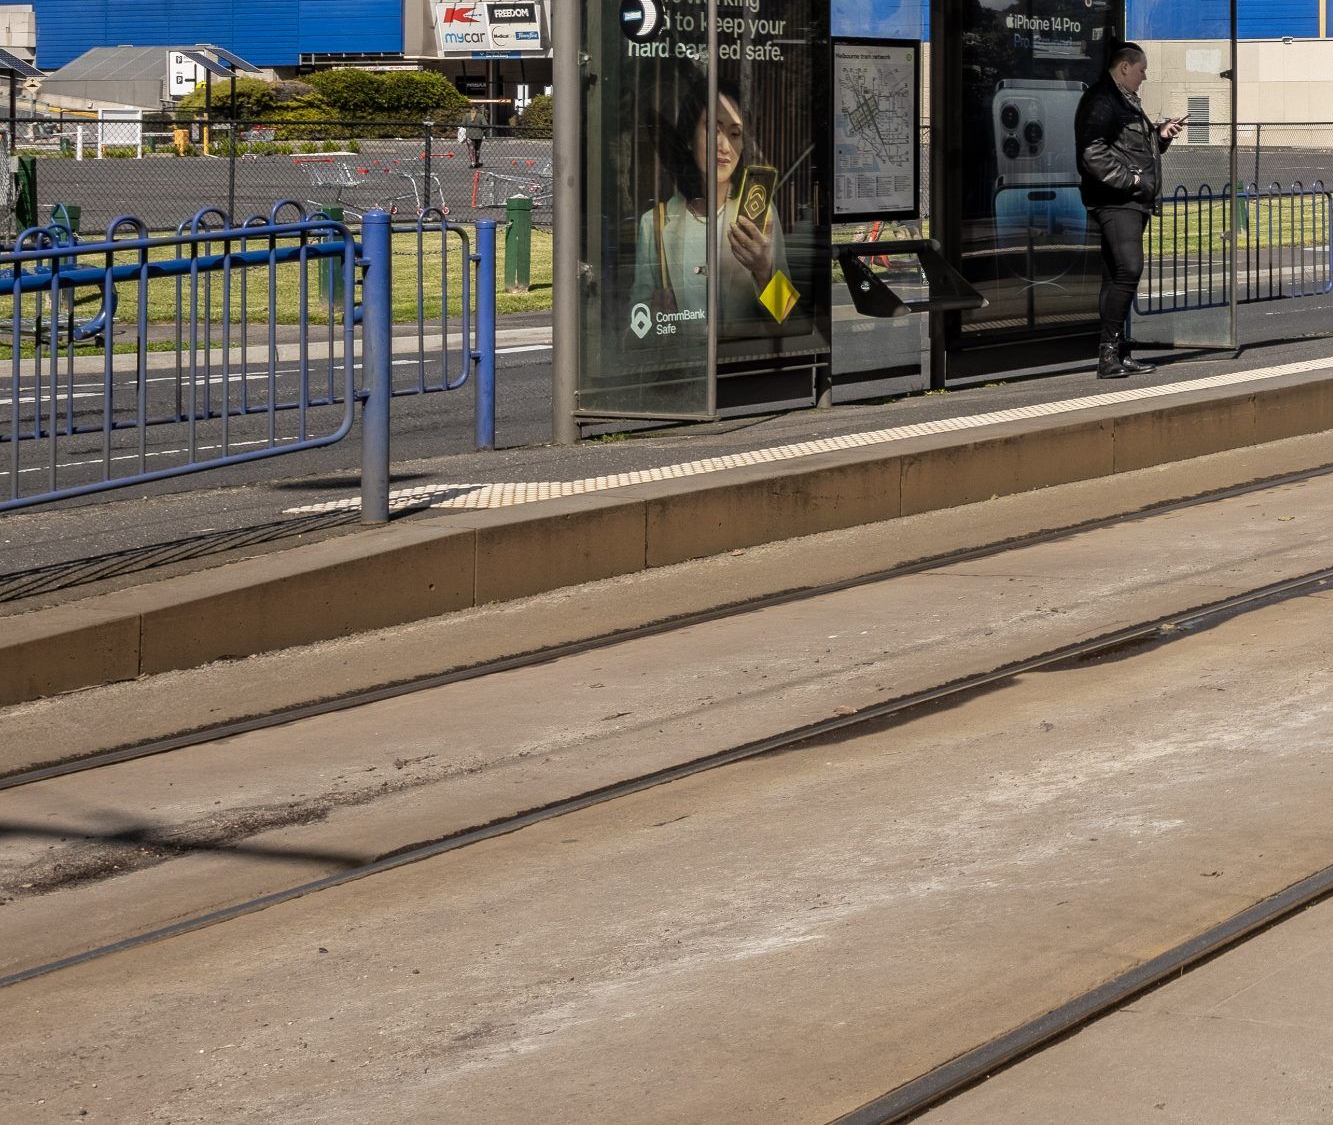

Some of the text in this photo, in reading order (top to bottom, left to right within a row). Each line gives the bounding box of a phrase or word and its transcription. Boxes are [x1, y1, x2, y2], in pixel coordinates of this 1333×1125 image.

[493, 8, 529, 18] FREEDOM
[675, 13, 695, 31] to
[749, 18, 786, 39] your
[1014, 14, 1081, 33] iPhone 14 Pro
[445, 32, 485, 43] mycar
[628, 37, 784, 61] hard eared safe.
[656, 308, 706, 323] CommBank
[656, 323, 677, 335] Safe
